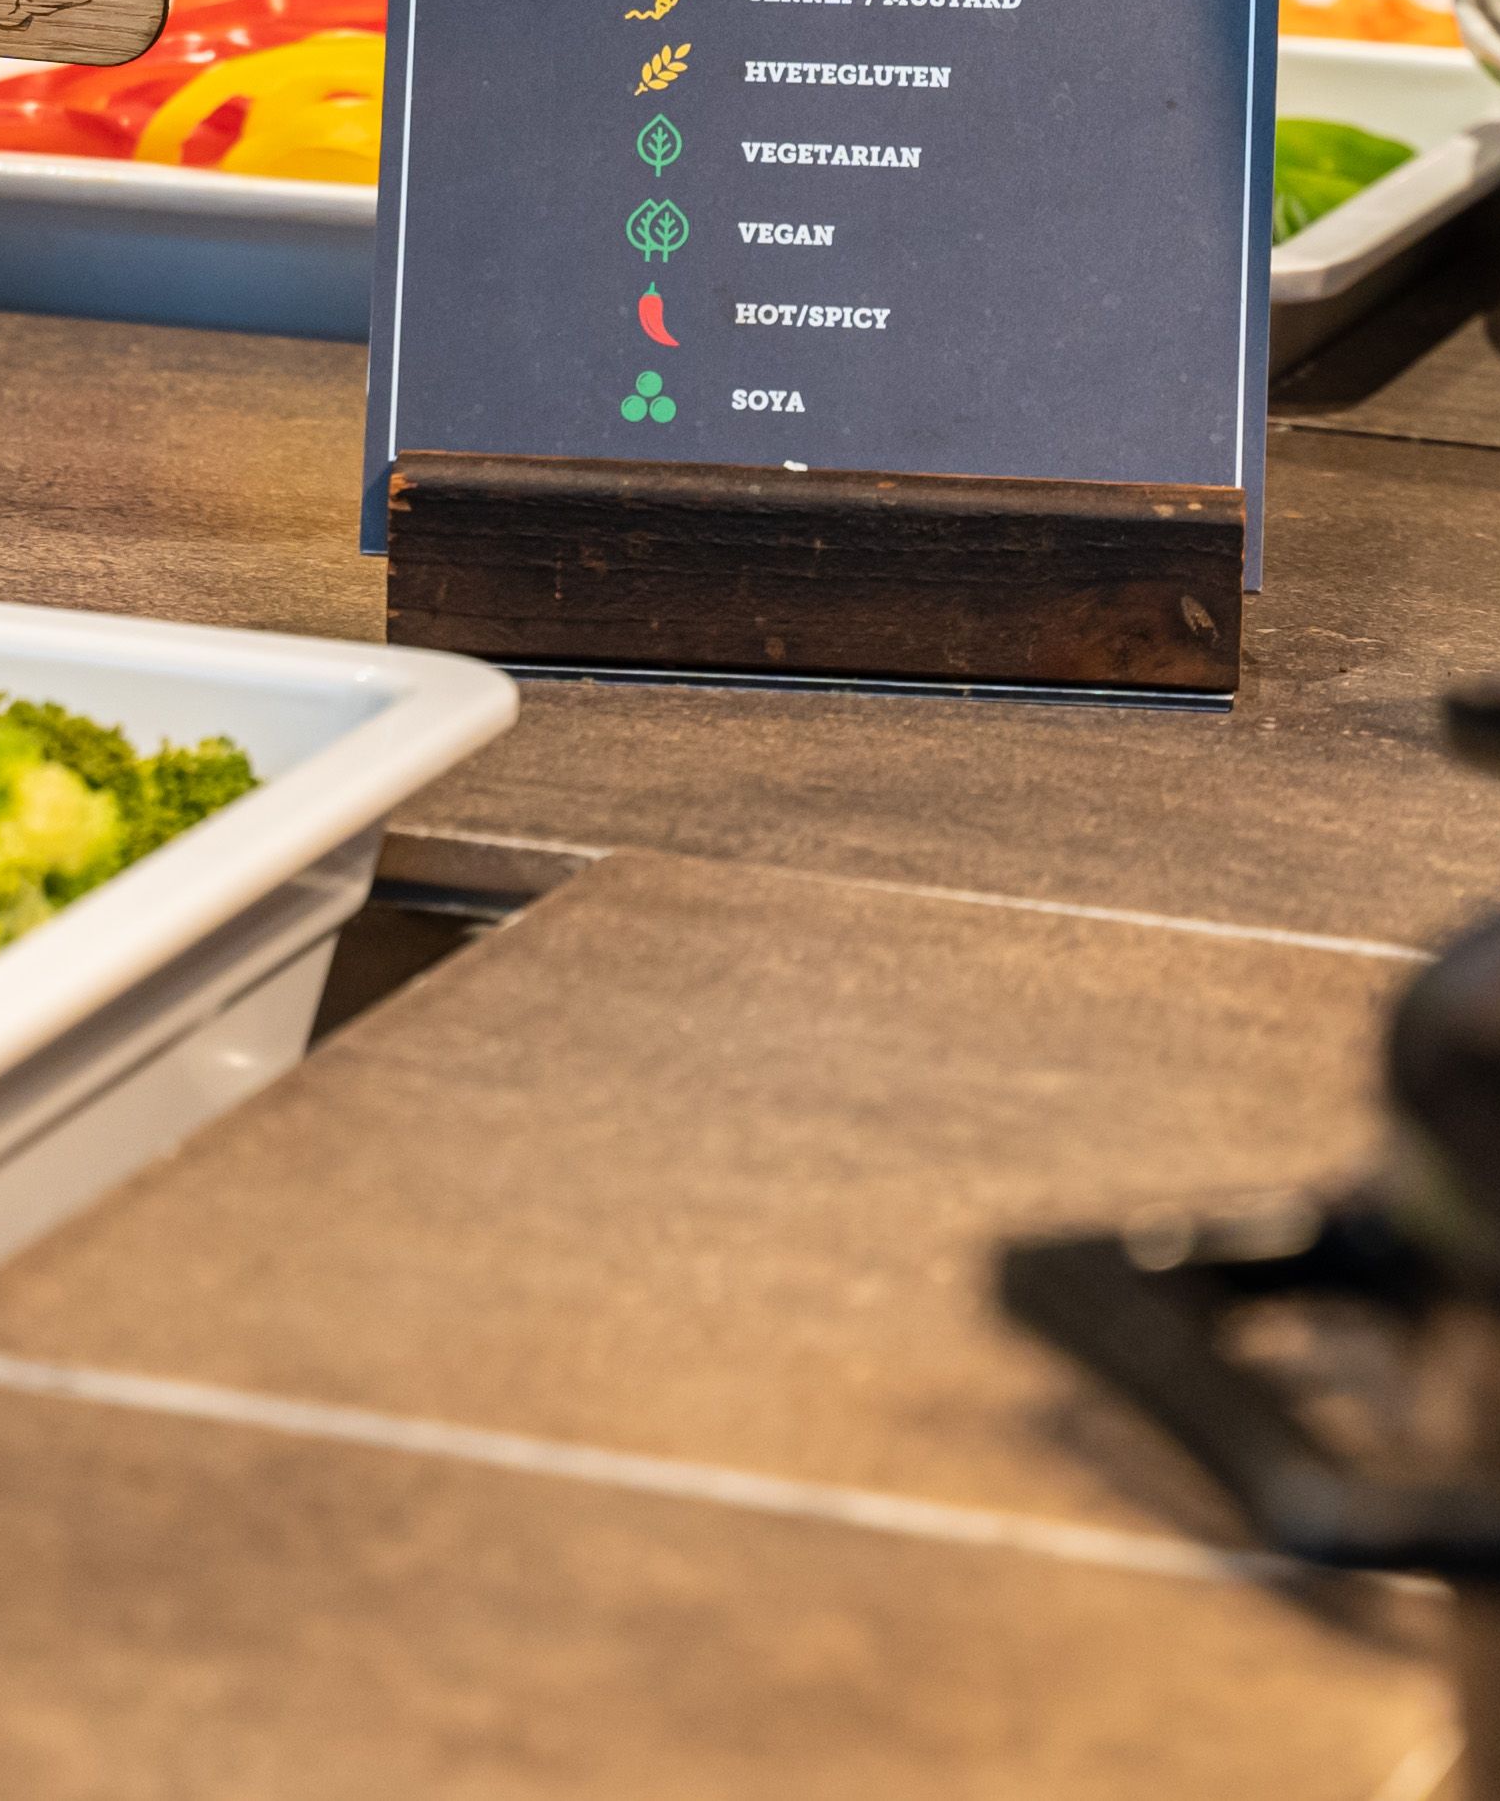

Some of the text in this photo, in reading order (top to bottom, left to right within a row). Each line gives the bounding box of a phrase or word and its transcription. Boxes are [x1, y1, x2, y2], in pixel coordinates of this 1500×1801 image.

[745, 61, 951, 88] HVETEGLUTEN
[741, 142, 922, 168] VEGETARIAN
[738, 222, 835, 246] VEGAN
[735, 303, 891, 329] HOT/SPICY
[732, 389, 805, 412] SOYA
